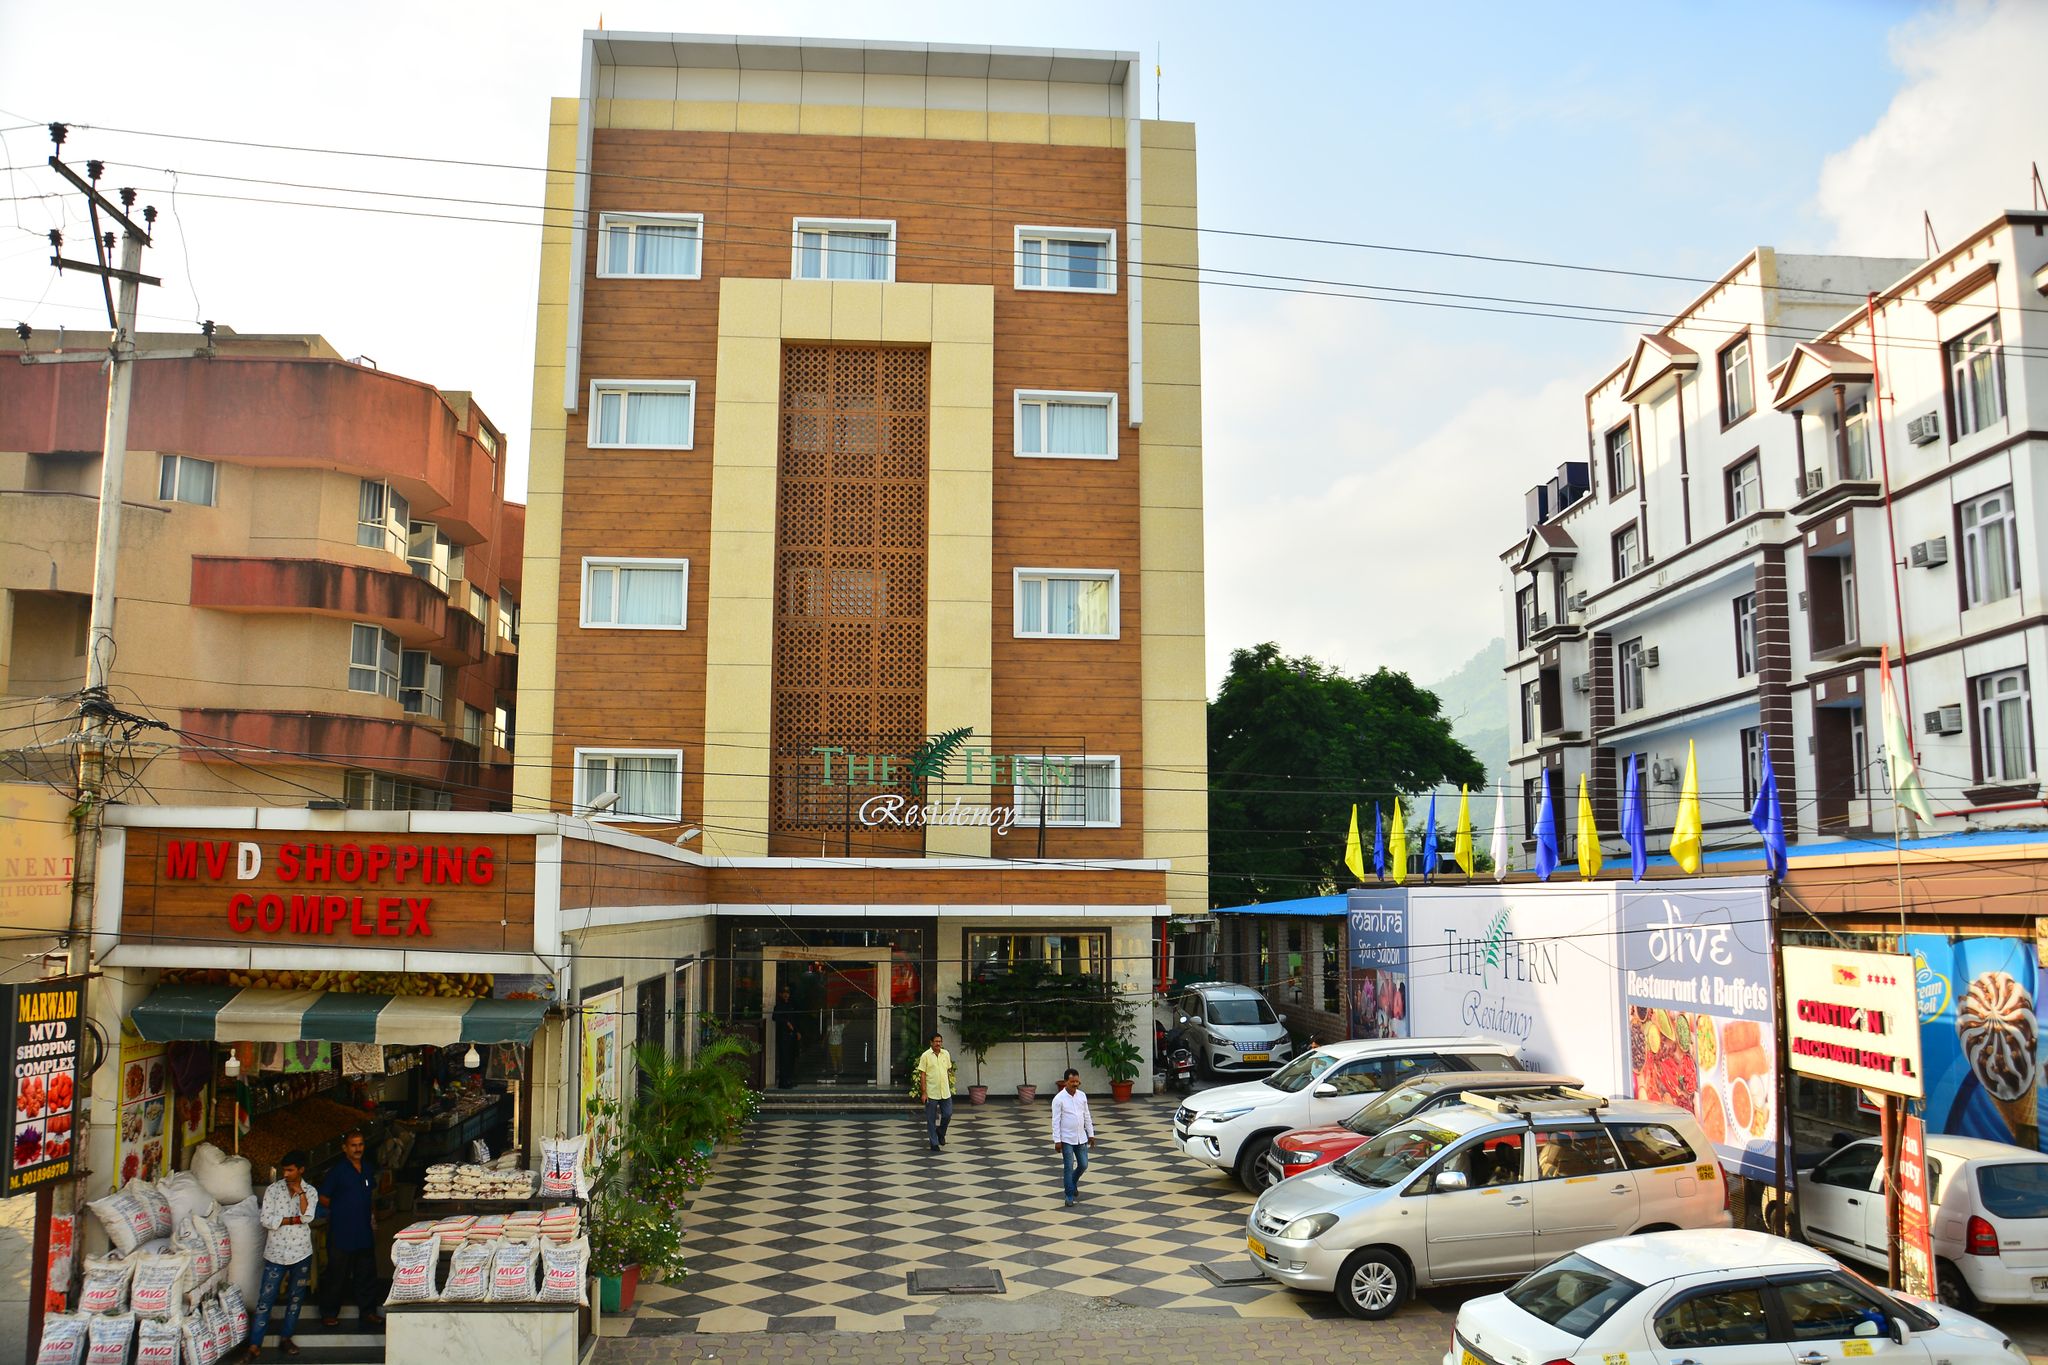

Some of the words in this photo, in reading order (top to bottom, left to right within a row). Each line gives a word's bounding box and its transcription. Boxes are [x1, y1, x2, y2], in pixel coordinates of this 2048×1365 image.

[811, 746, 898, 786] THE
[962, 747, 1075, 788] FERN
[858, 794, 1019, 836] Residency
[166, 840, 263, 881] MVD
[276, 842, 495, 885] SHOPPING
[16, 885, 62, 897] HOTEL
[228, 893, 433, 937] COMPLEX
[1351, 904, 1403, 934] mantra
[1646, 899, 1733, 966] olive
[1444, 929, 1482, 976] THE
[1503, 931, 1559, 985] FERN
[18, 990, 78, 1023] MARWADI
[1627, 970, 1698, 1004] Restaurant
[1700, 975, 1712, 1005] &
[1713, 976, 1768, 1015] Buffets
[29, 1021, 67, 1042] MVD
[1462, 989, 1533, 1051] Residency
[1796, 999, 1895, 1036] CONTINN
[17, 1040, 76, 1061] SHOPPING
[1860, 1051, 1916, 1078] HOTL
[15, 1055, 75, 1079] COMPLEX
[497, 1266, 526, 1276] MVD
[549, 1269, 576, 1278] MVD
[136, 1289, 167, 1299] MVD
[42, 1341, 74, 1351] MVD
[141, 1347, 173, 1356] MVD
